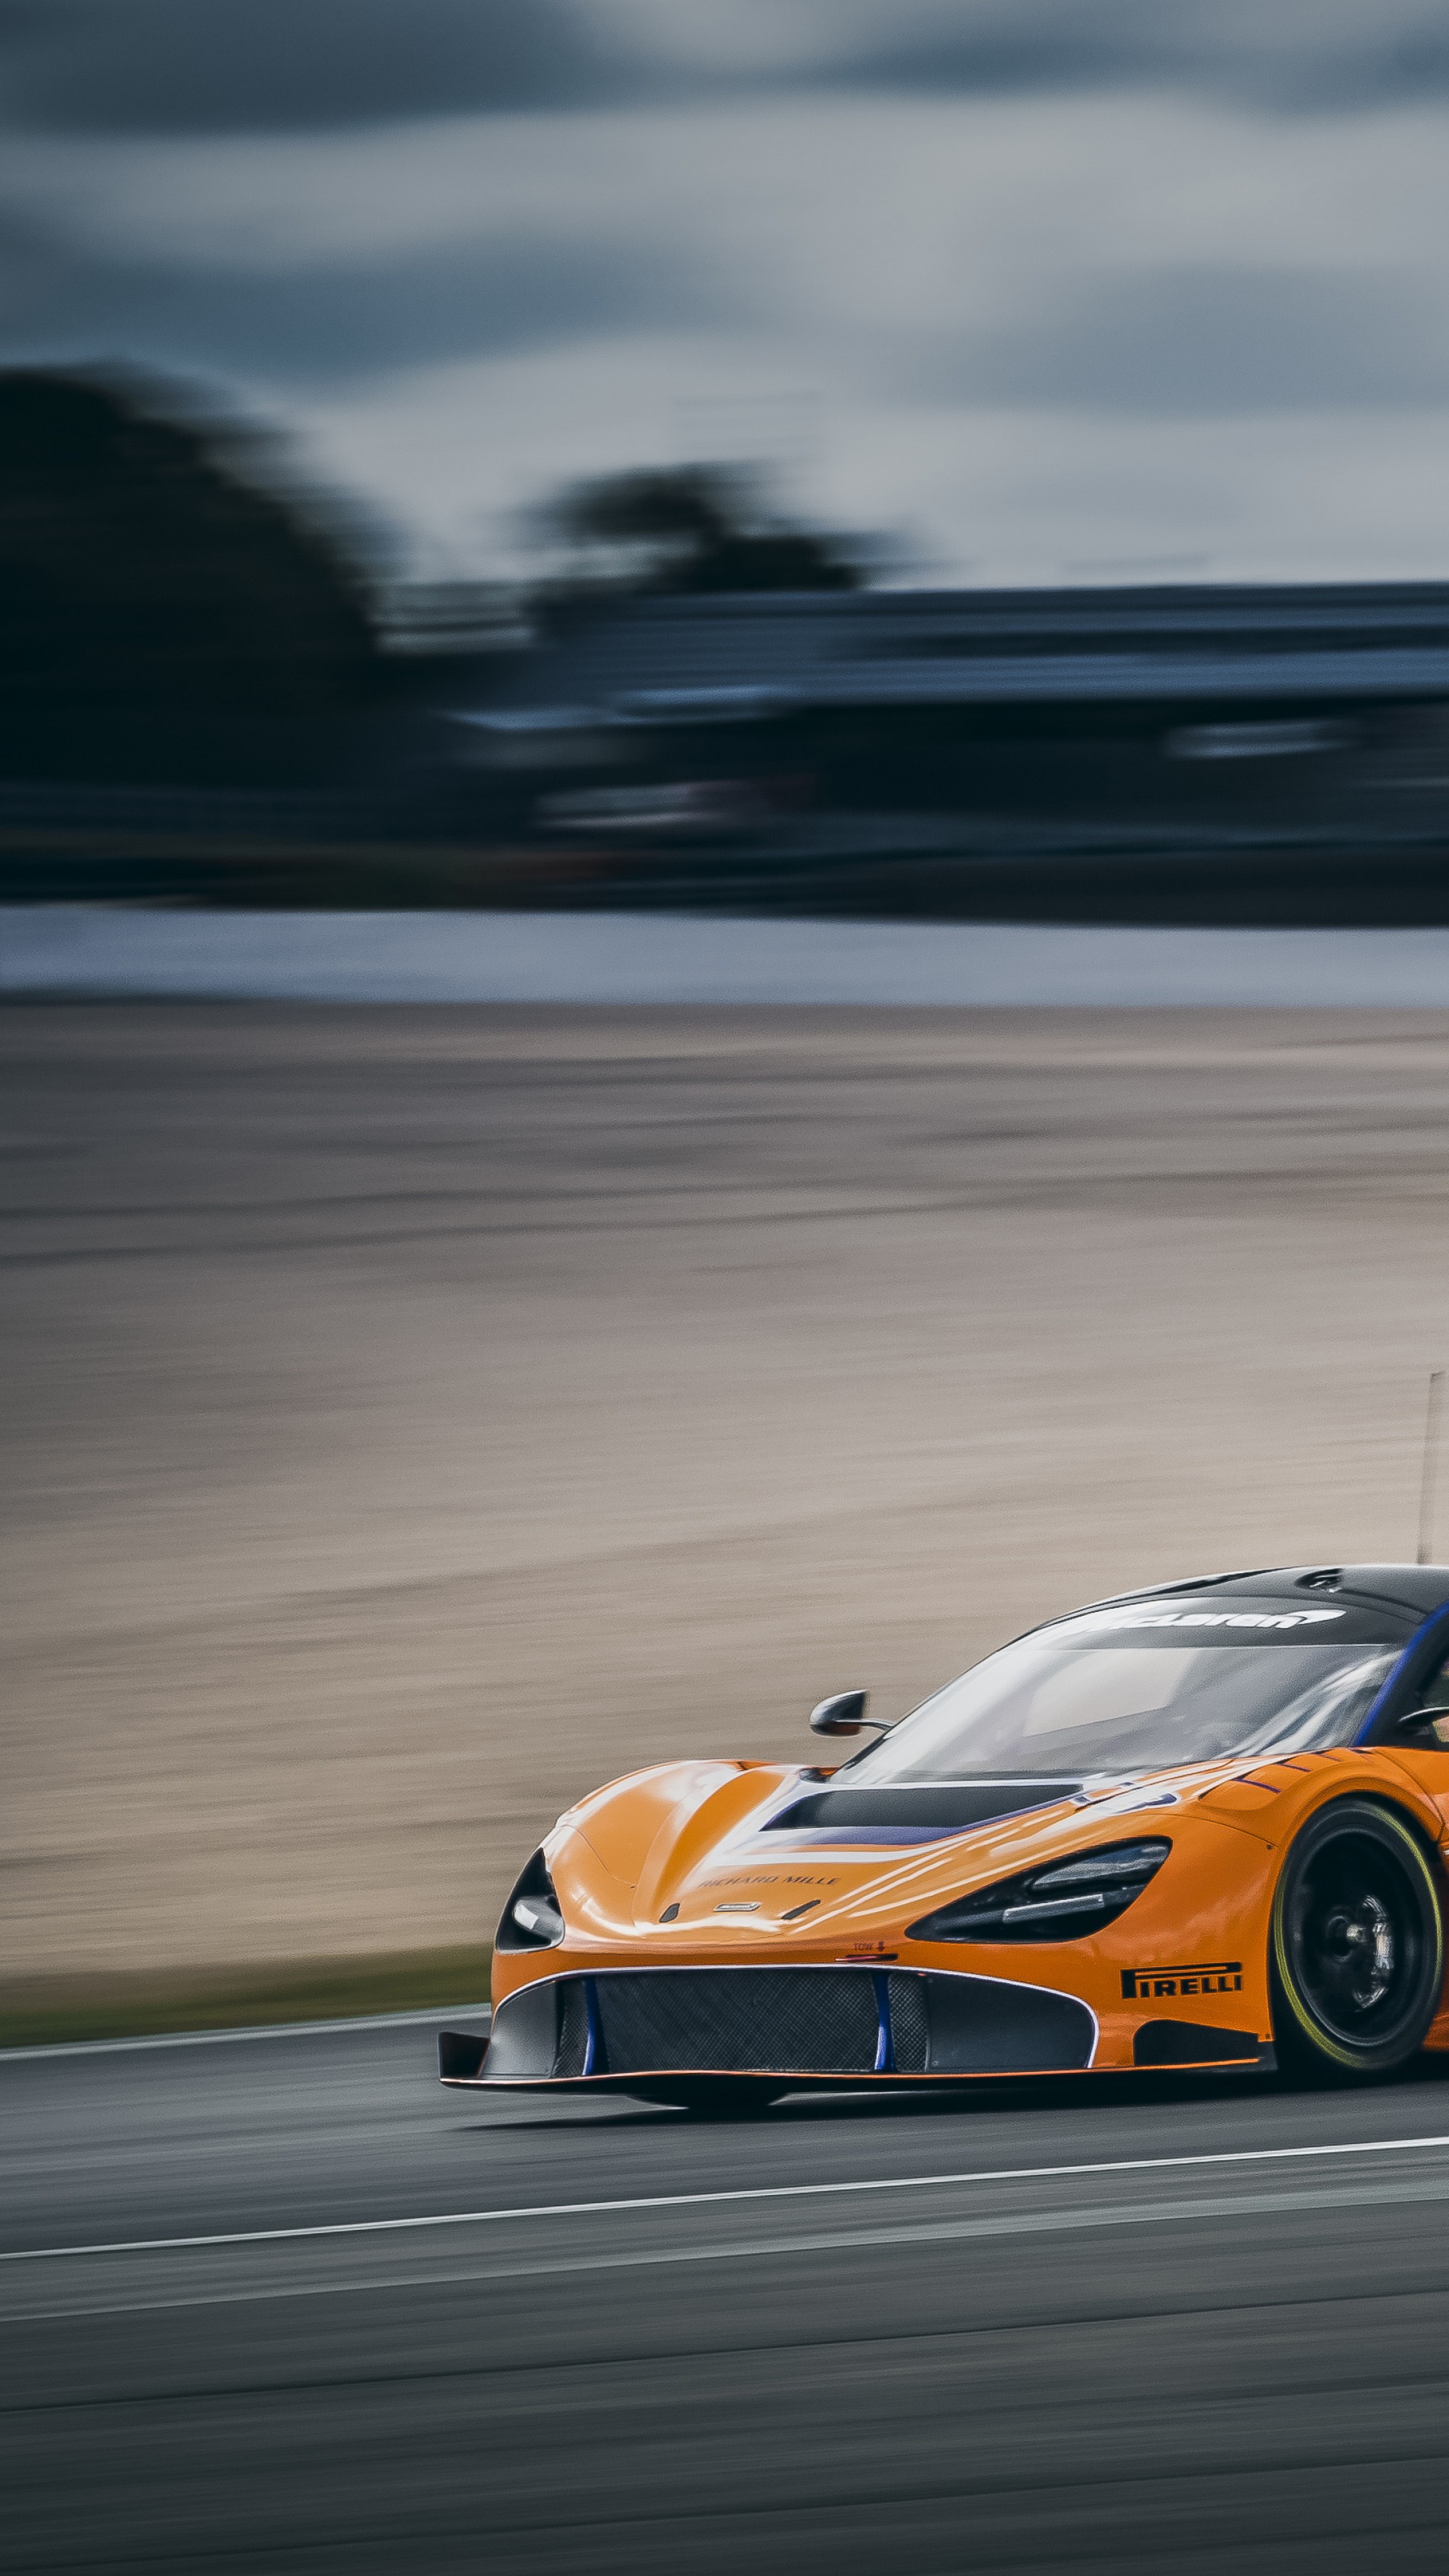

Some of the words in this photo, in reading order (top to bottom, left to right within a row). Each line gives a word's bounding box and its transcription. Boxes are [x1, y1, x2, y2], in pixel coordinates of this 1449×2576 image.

[698, 1876, 779, 1888] RICHARD
[783, 1876, 838, 1885] MILLE
[854, 1942, 873, 1951] TOW
[1121, 1962, 1242, 1998] PIRELLI
